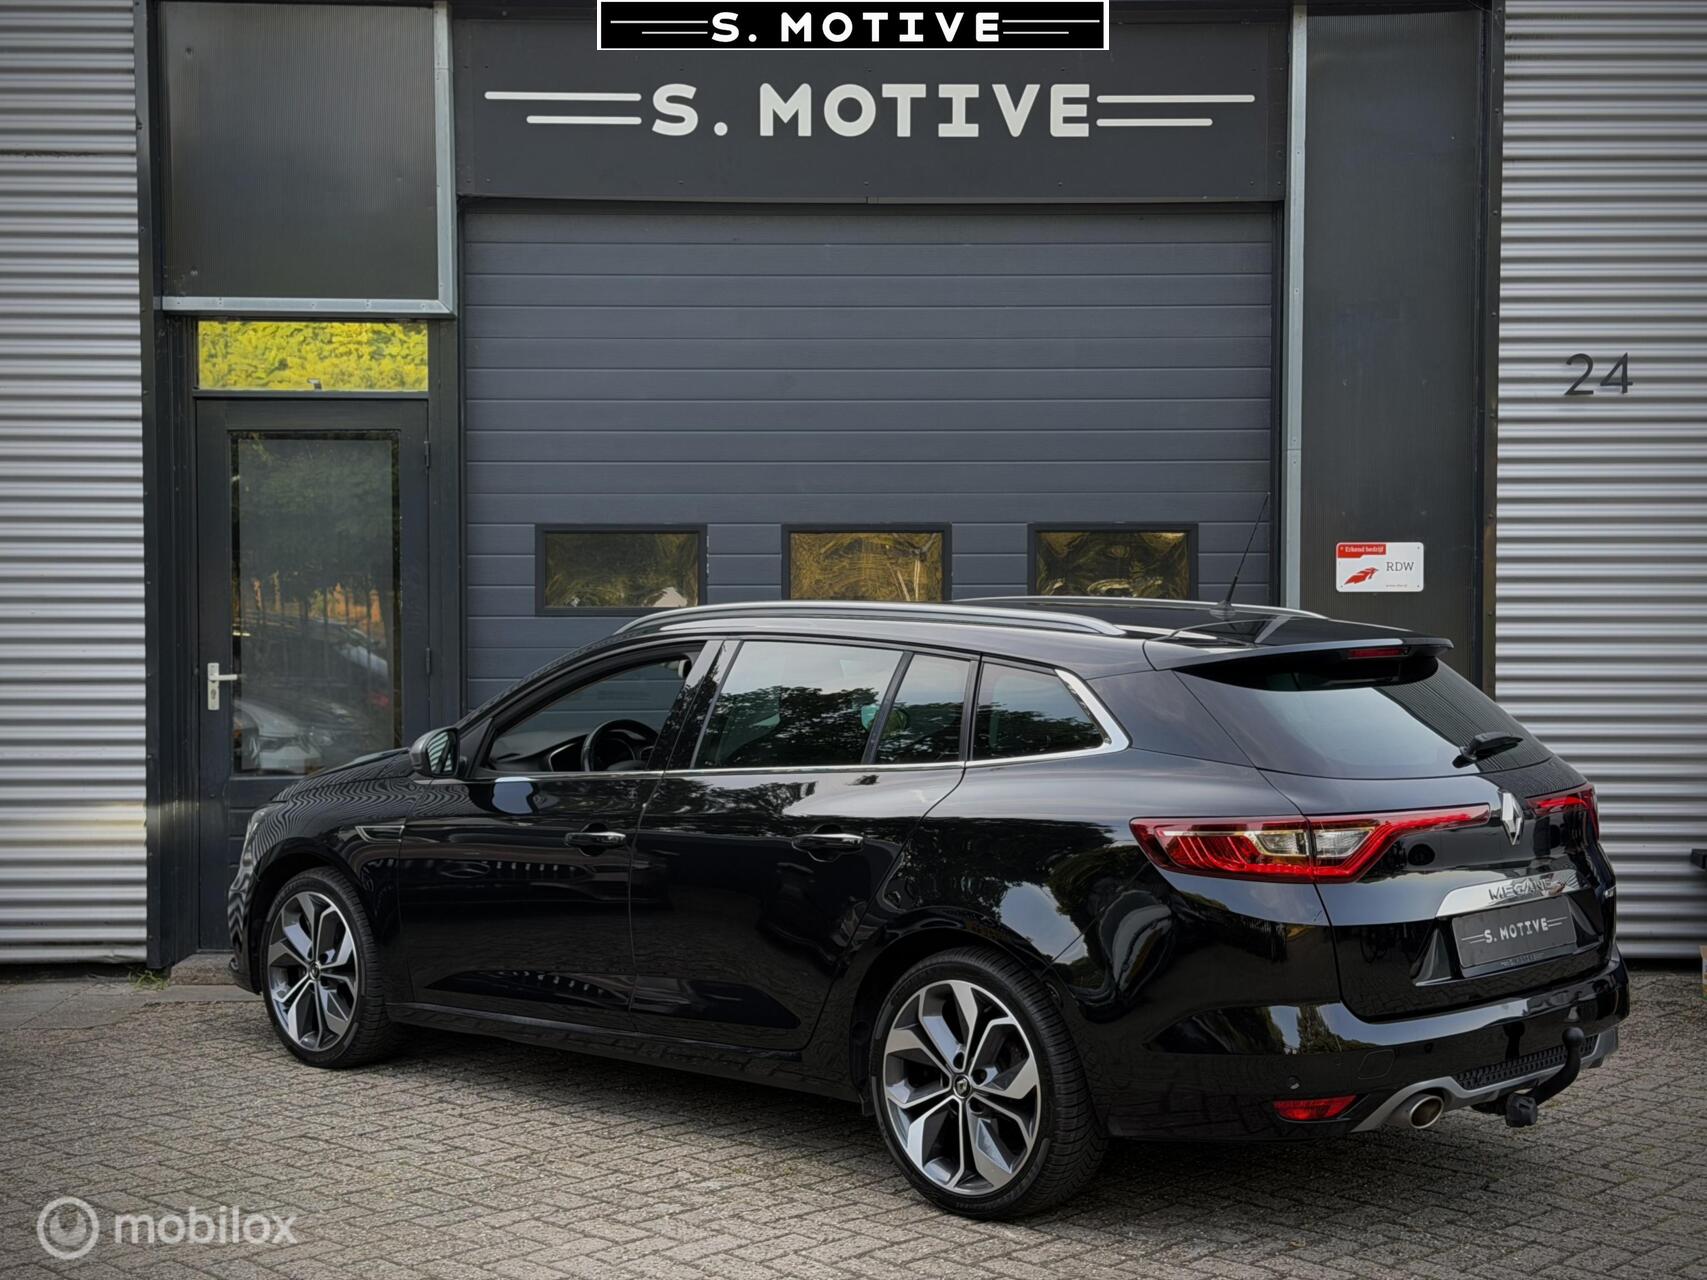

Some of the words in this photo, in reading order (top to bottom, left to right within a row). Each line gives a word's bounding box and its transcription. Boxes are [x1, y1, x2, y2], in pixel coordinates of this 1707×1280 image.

[652, 83, 728, 137] S.
[760, 83, 1090, 137] MOTIVE
[1564, 352, 1633, 396] 24
[1386, 561, 1414, 572] RDW
[1484, 928, 1498, 944] S.
[1500, 917, 1548, 941] MOTIVE
